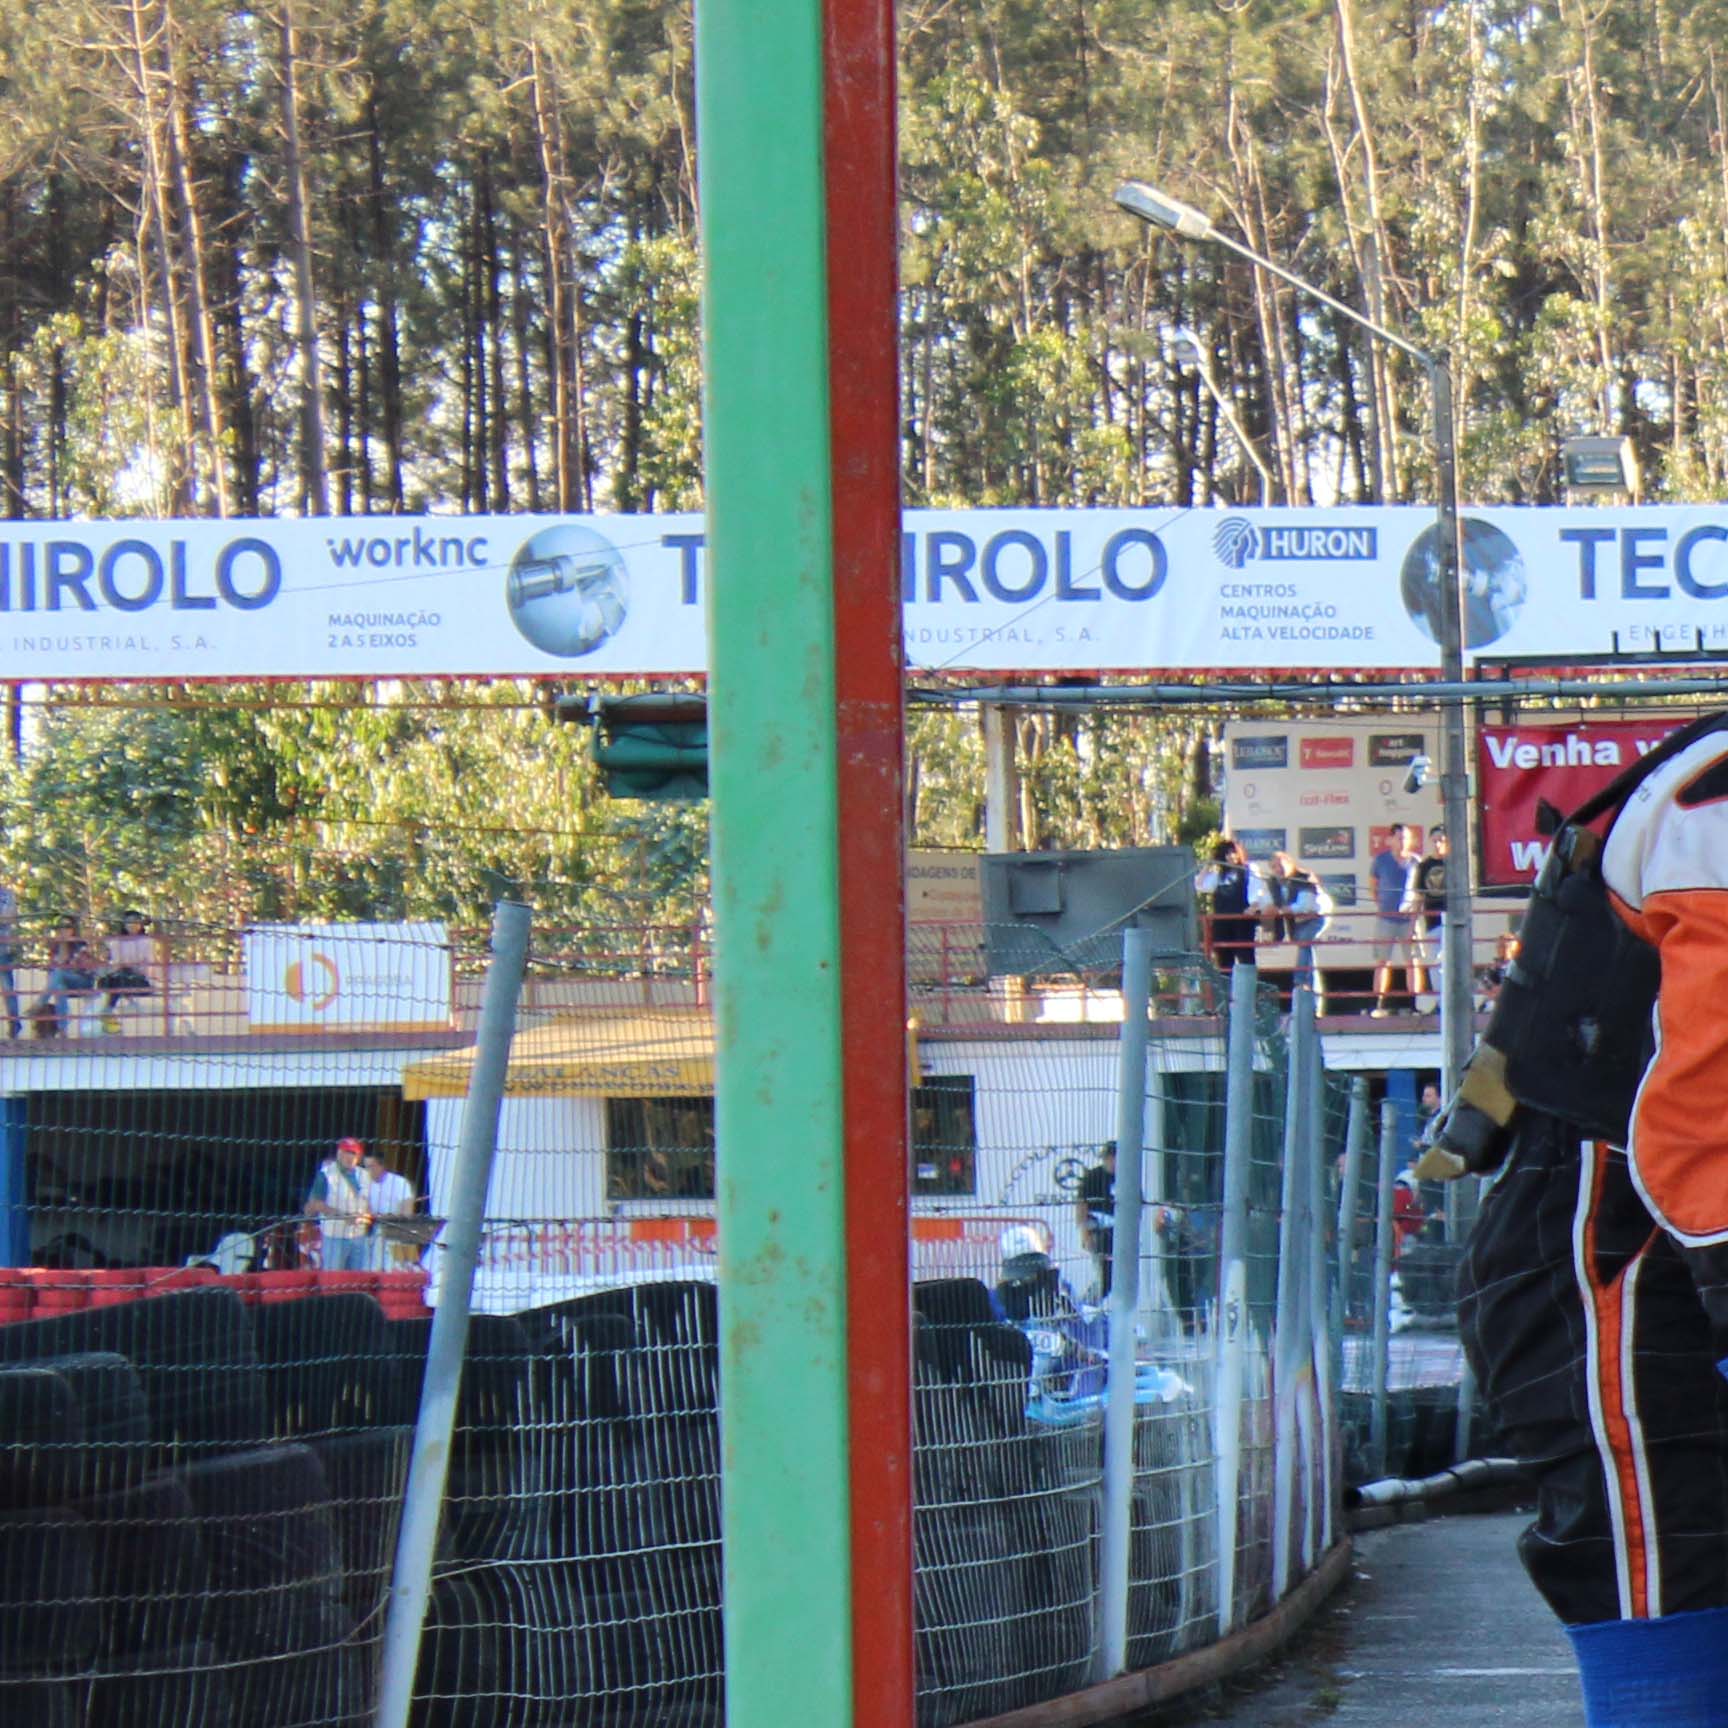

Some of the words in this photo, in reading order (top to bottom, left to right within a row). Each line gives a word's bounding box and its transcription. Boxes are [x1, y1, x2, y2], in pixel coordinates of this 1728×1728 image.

[326, 526, 489, 567] worknc
[1270, 530, 1369, 557] HURON
[1219, 583, 1297, 599] CENTROS
[328, 611, 442, 631] MAQUINAÇÃO
[1219, 602, 1337, 622] MAQUINAÇÃO
[171, 634, 217, 651] S.A.
[328, 634, 337, 648] 2
[341, 634, 354, 648] A
[356, 634, 366, 648] 5
[368, 633, 417, 648] EIXOS
[1220, 626, 1264, 641] ALTA
[1267, 625, 1376, 641] VELOCIDADE
[1484, 734, 1621, 769] Venha
